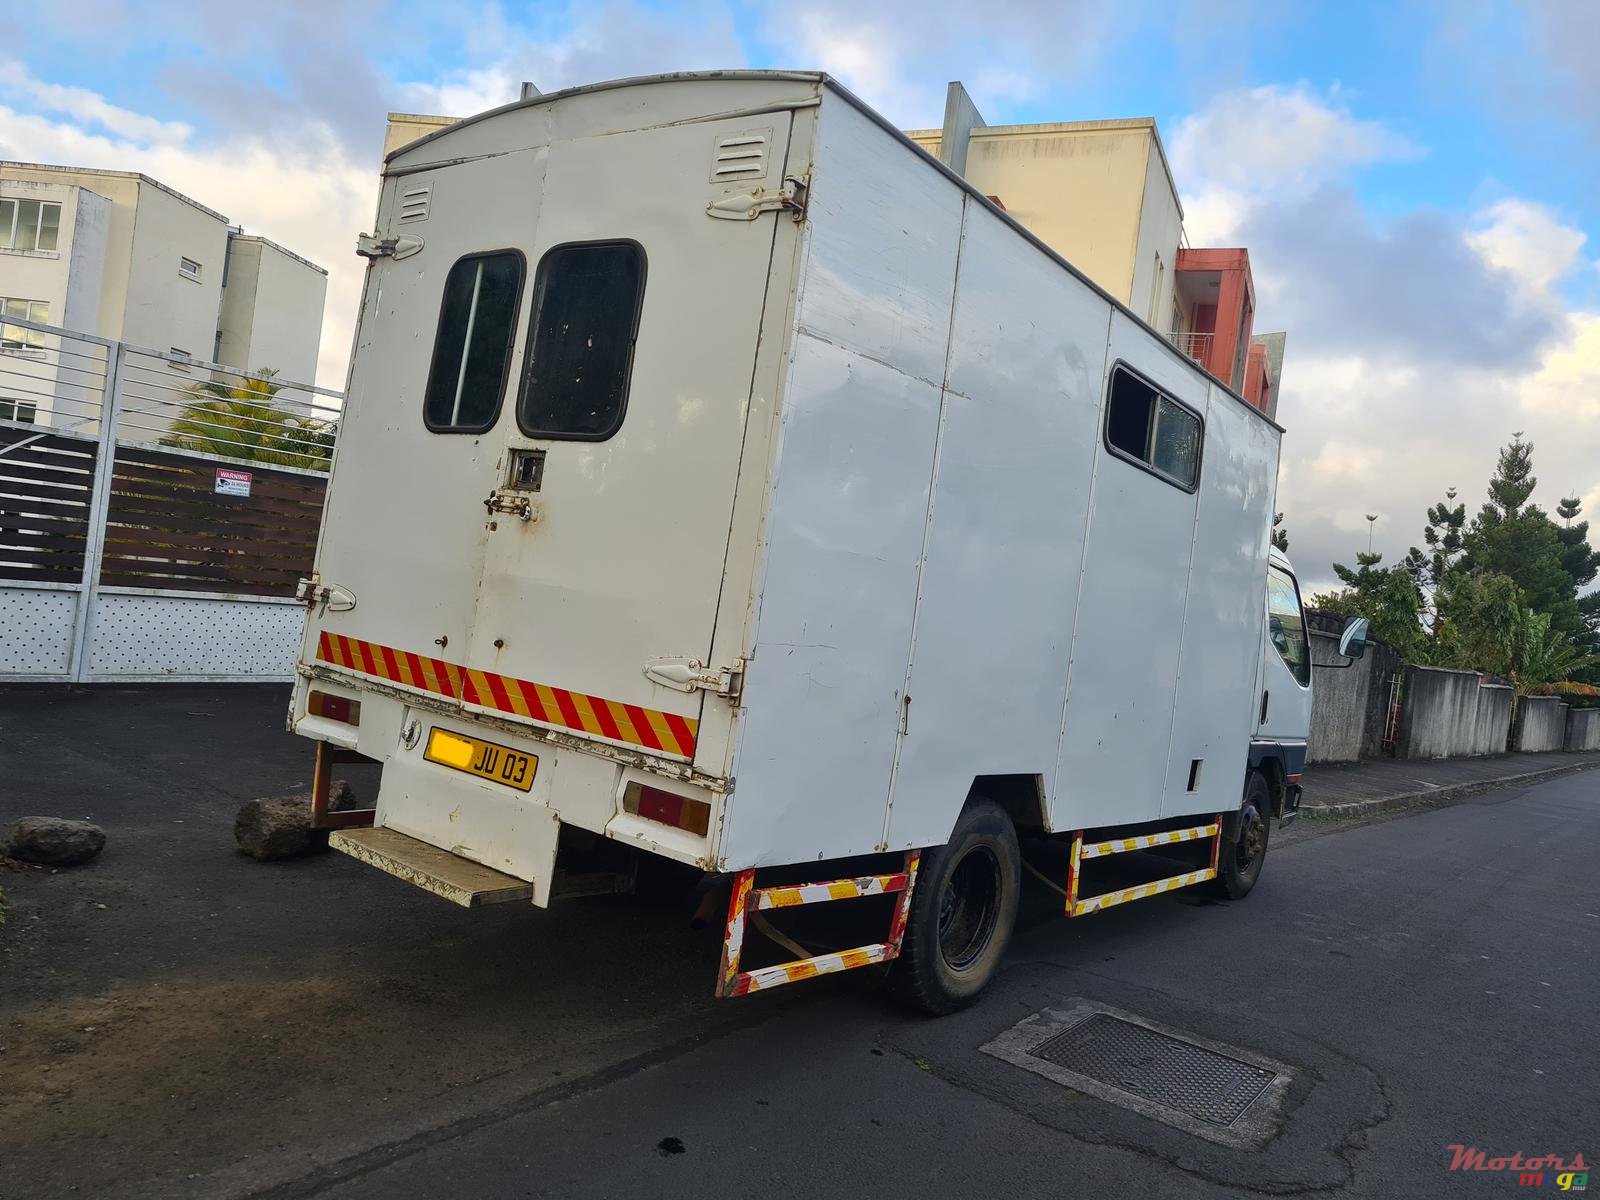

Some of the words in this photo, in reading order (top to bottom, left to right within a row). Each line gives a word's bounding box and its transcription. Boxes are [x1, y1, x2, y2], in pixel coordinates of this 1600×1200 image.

[220, 471, 248, 481] WARNING
[474, 746, 499, 774] JU
[502, 753, 528, 783] 03
